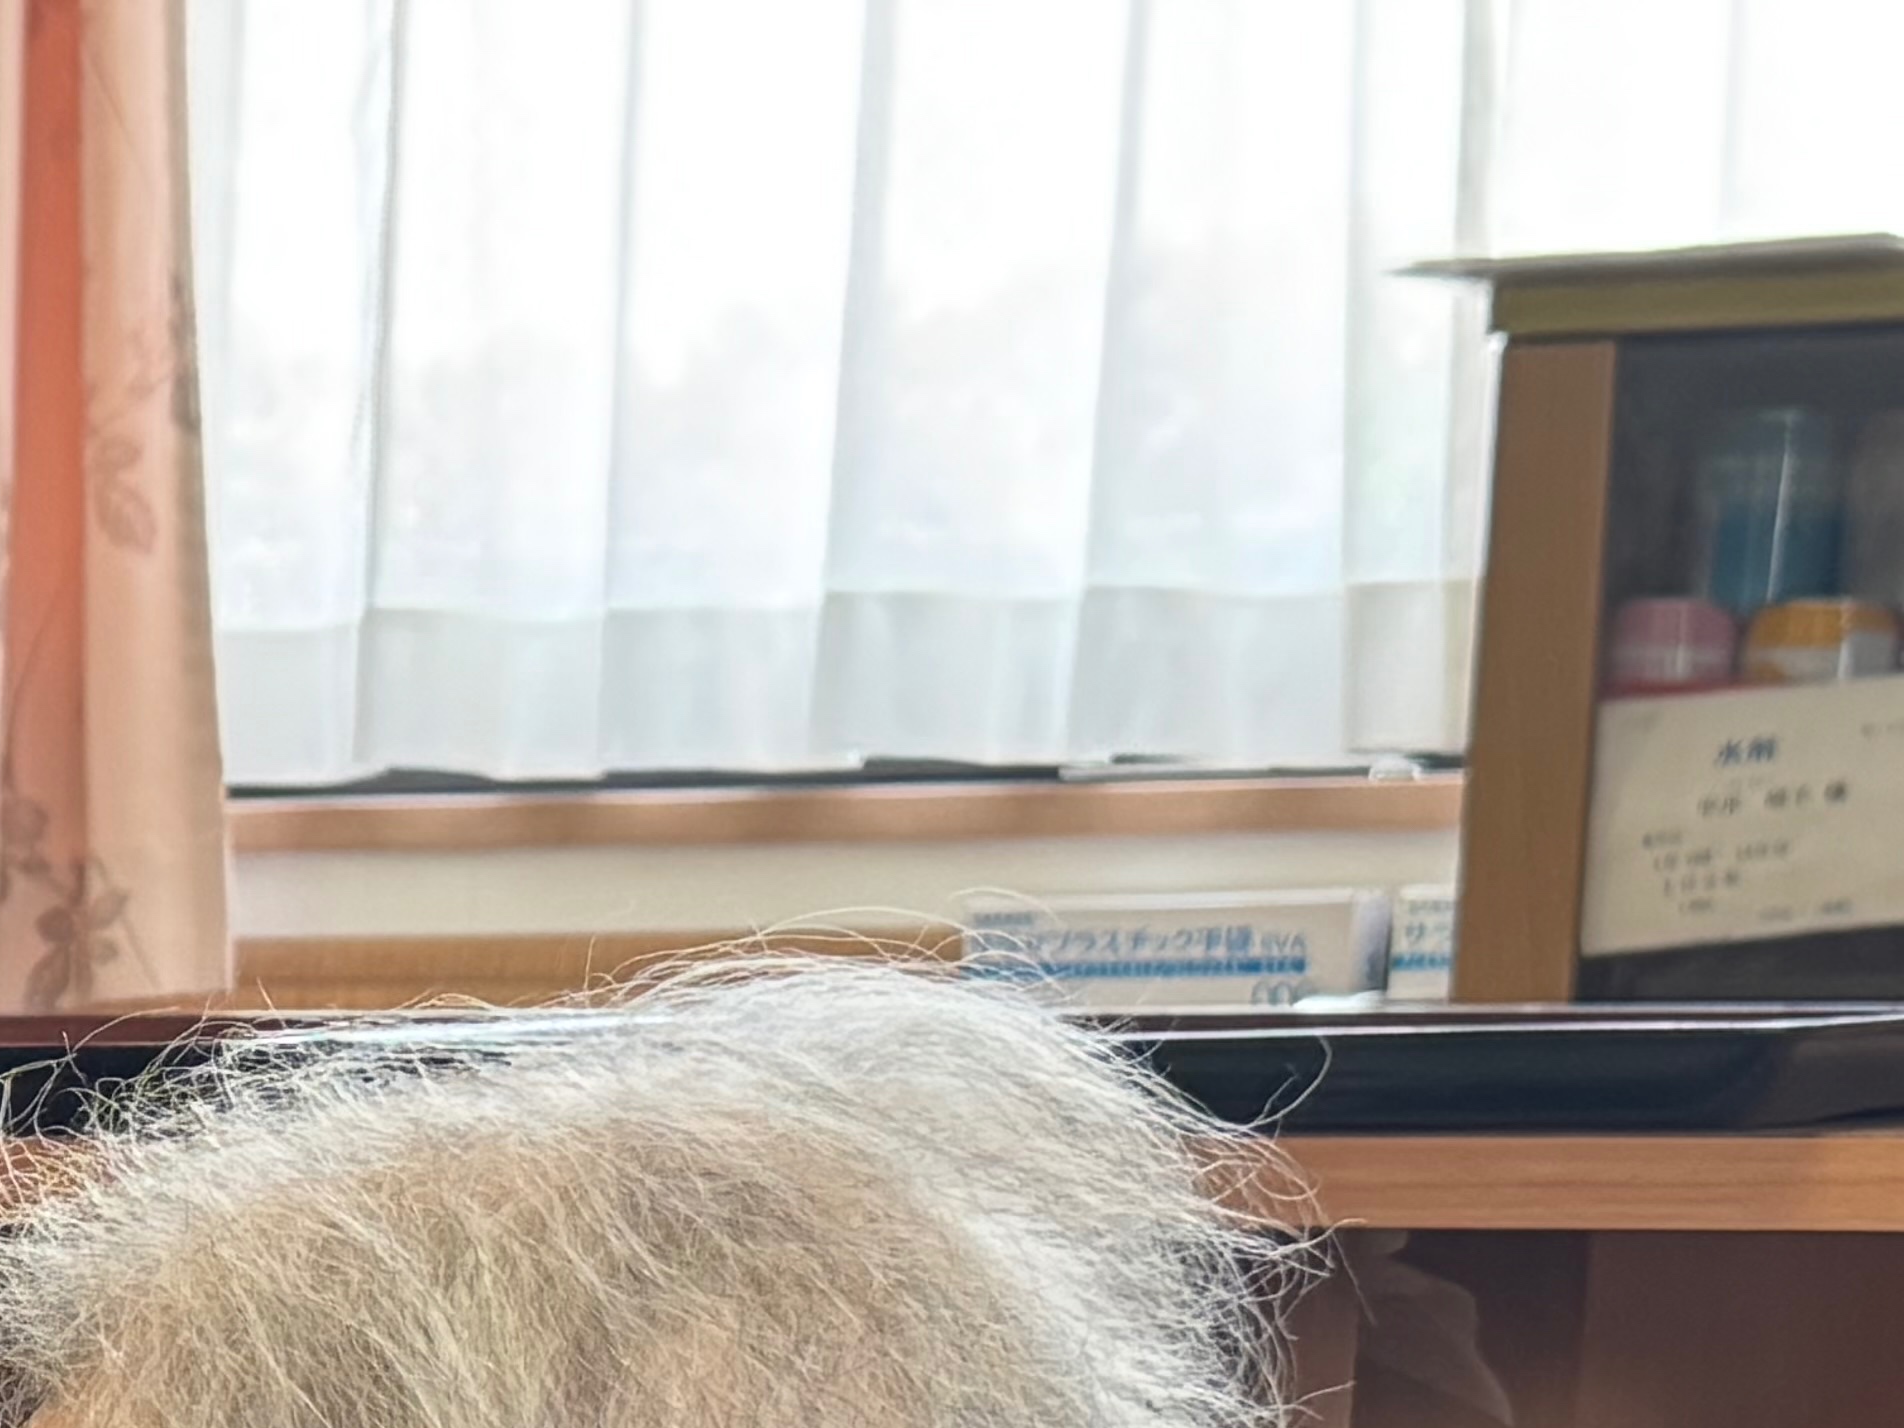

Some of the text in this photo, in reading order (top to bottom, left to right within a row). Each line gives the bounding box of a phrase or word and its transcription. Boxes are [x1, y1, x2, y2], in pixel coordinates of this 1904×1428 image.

[972, 923, 1256, 960] プラスチック手袋
